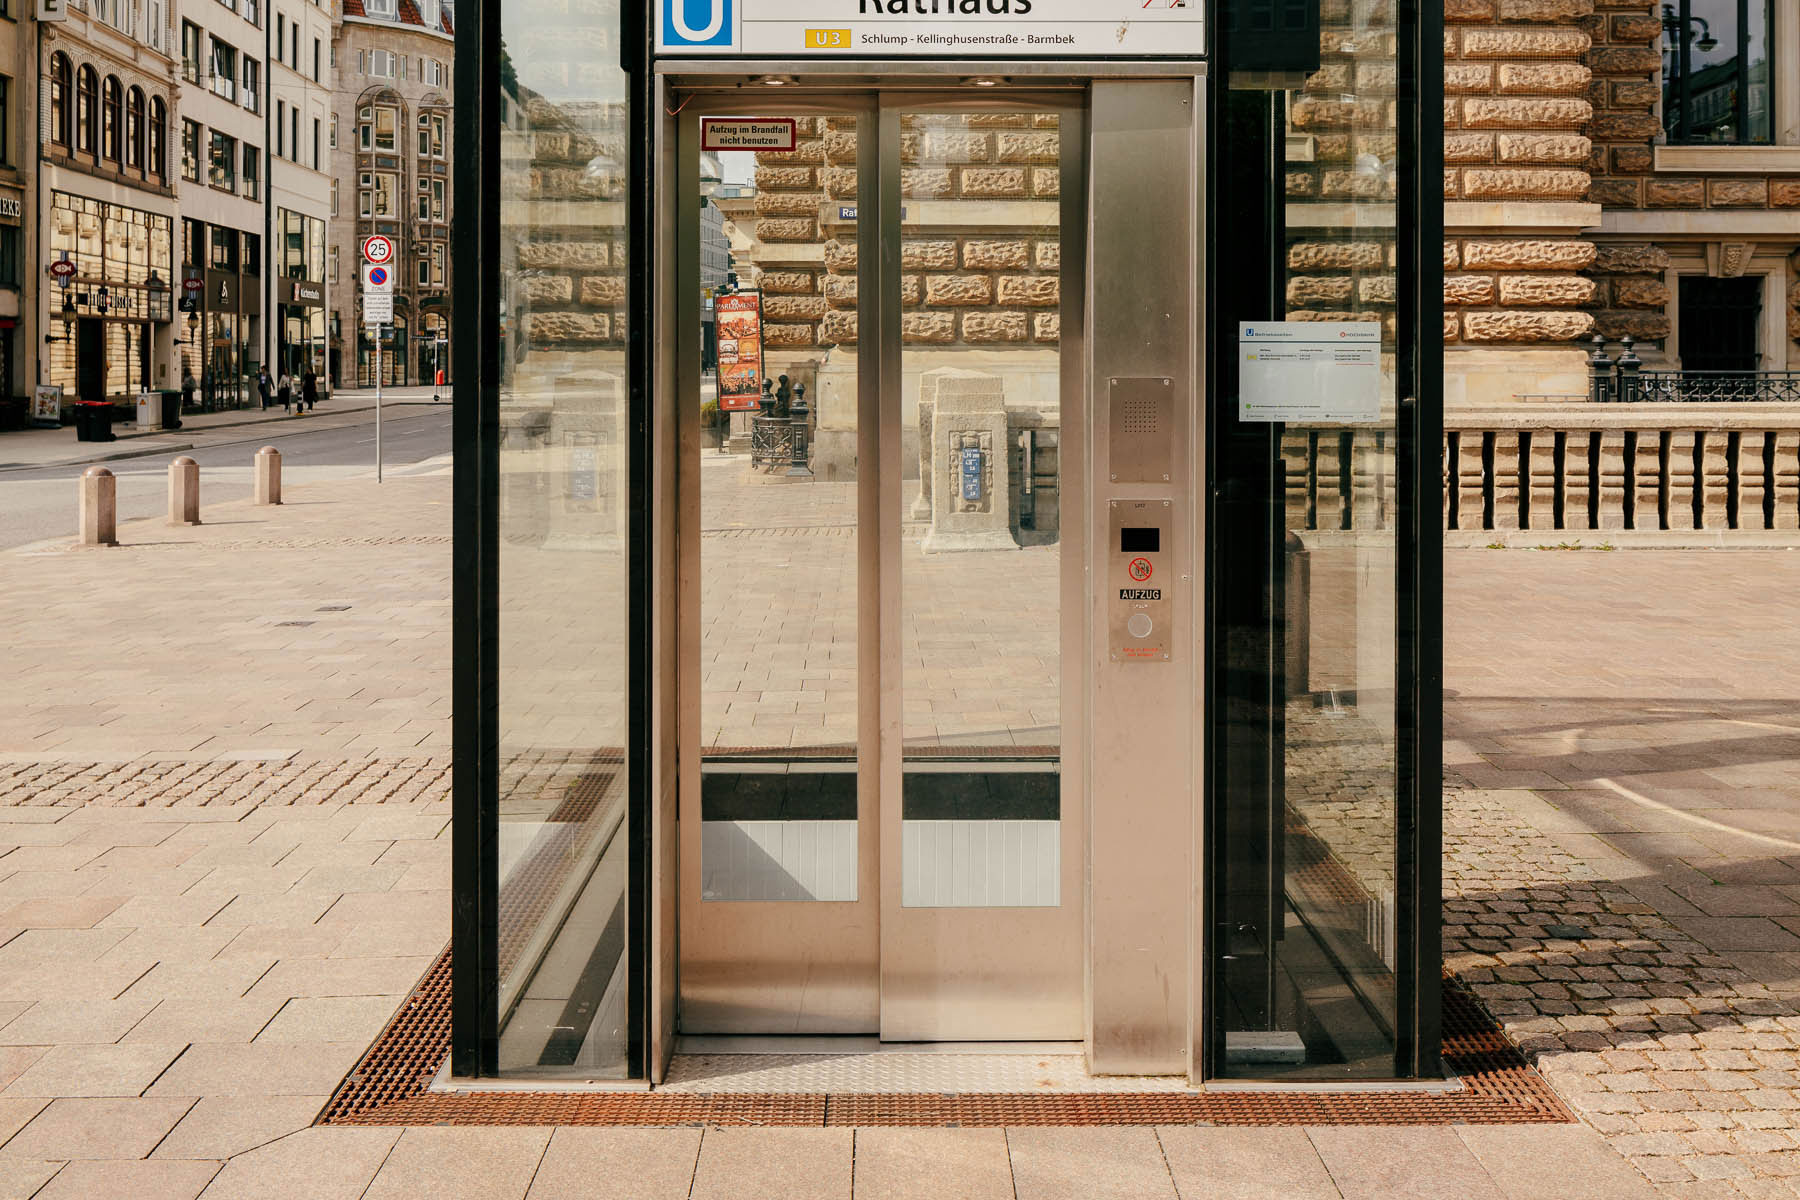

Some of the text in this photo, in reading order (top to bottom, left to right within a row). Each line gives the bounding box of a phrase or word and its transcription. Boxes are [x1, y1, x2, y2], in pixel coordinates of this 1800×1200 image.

[861, 34, 908, 45] Schlump
[916, 34, 1018, 45] Kellinghusenstraße
[1027, 34, 1075, 44] Barmbek
[710, 125, 789, 135] Aufzug im Brandfall
[719, 136, 779, 145] nicht benutzen
[370, 243, 386, 256] 25
[1121, 590, 1160, 600] AUFZUG
